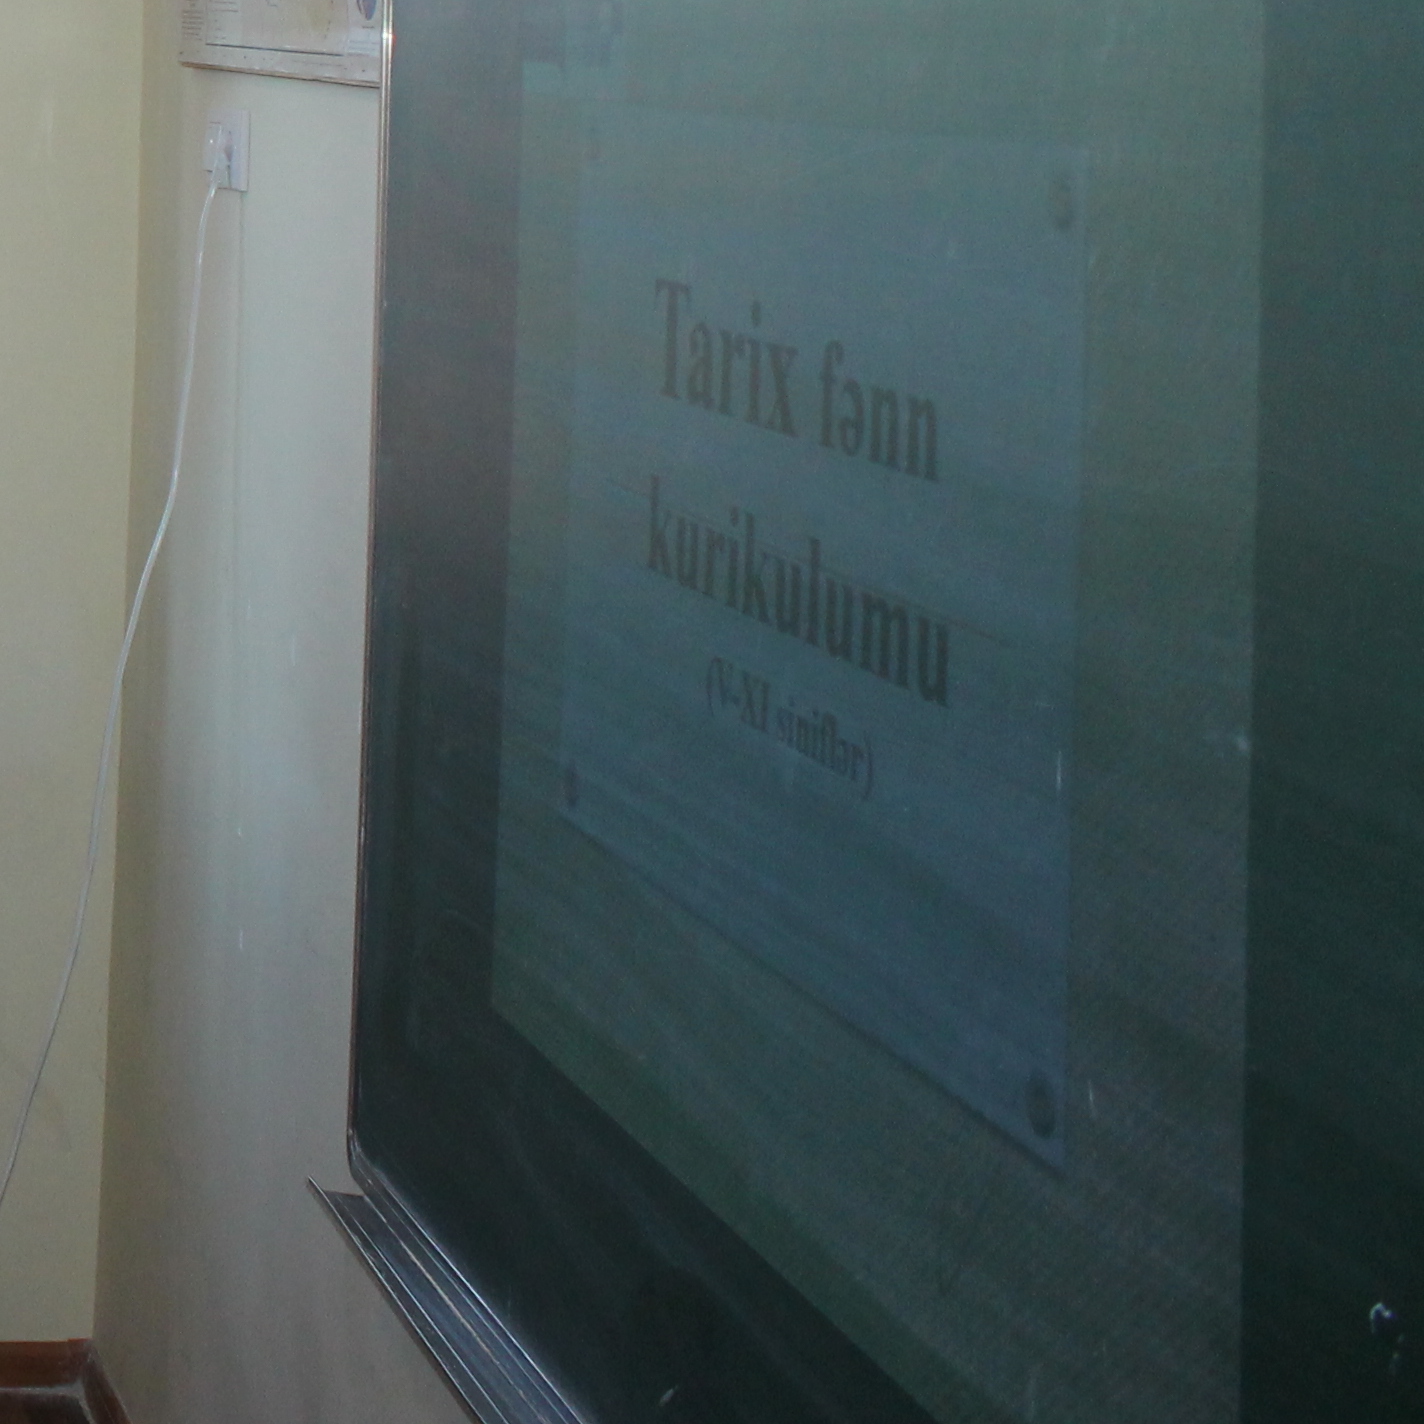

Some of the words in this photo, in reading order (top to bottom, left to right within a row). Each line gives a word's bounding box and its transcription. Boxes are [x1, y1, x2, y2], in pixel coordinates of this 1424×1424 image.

[655, 278, 799, 437] Tarix
[818, 339, 940, 482] fənn
[649, 475, 950, 709] kurikulumu
